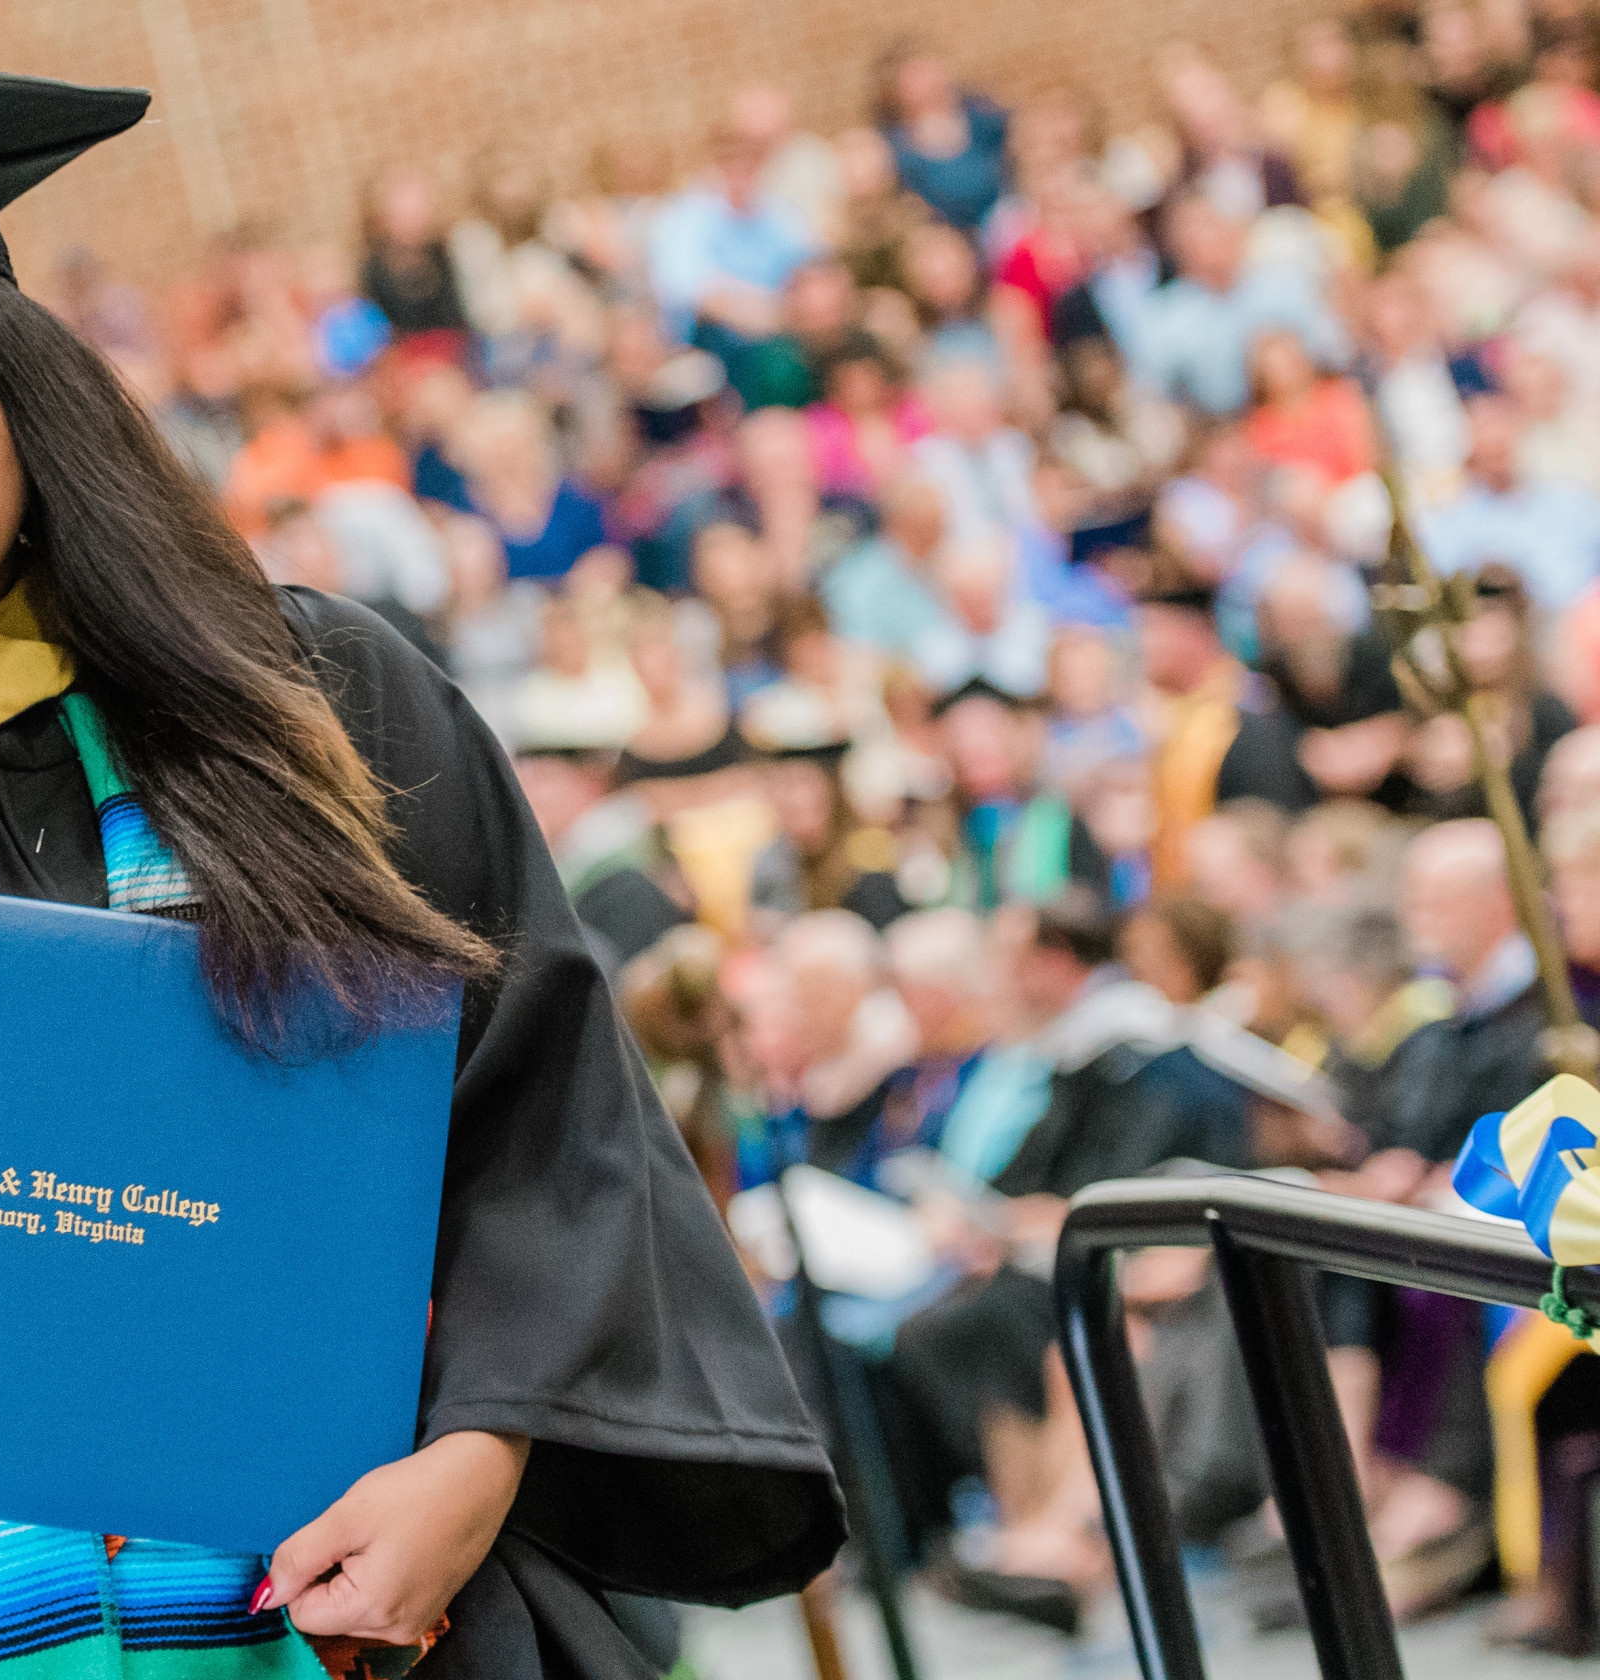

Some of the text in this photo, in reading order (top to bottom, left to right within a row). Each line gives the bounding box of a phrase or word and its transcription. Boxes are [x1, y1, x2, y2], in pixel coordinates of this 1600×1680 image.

[29, 1170, 115, 1214] Henry
[121, 1183, 221, 1227] College
[53, 1209, 146, 1245] Virginia
